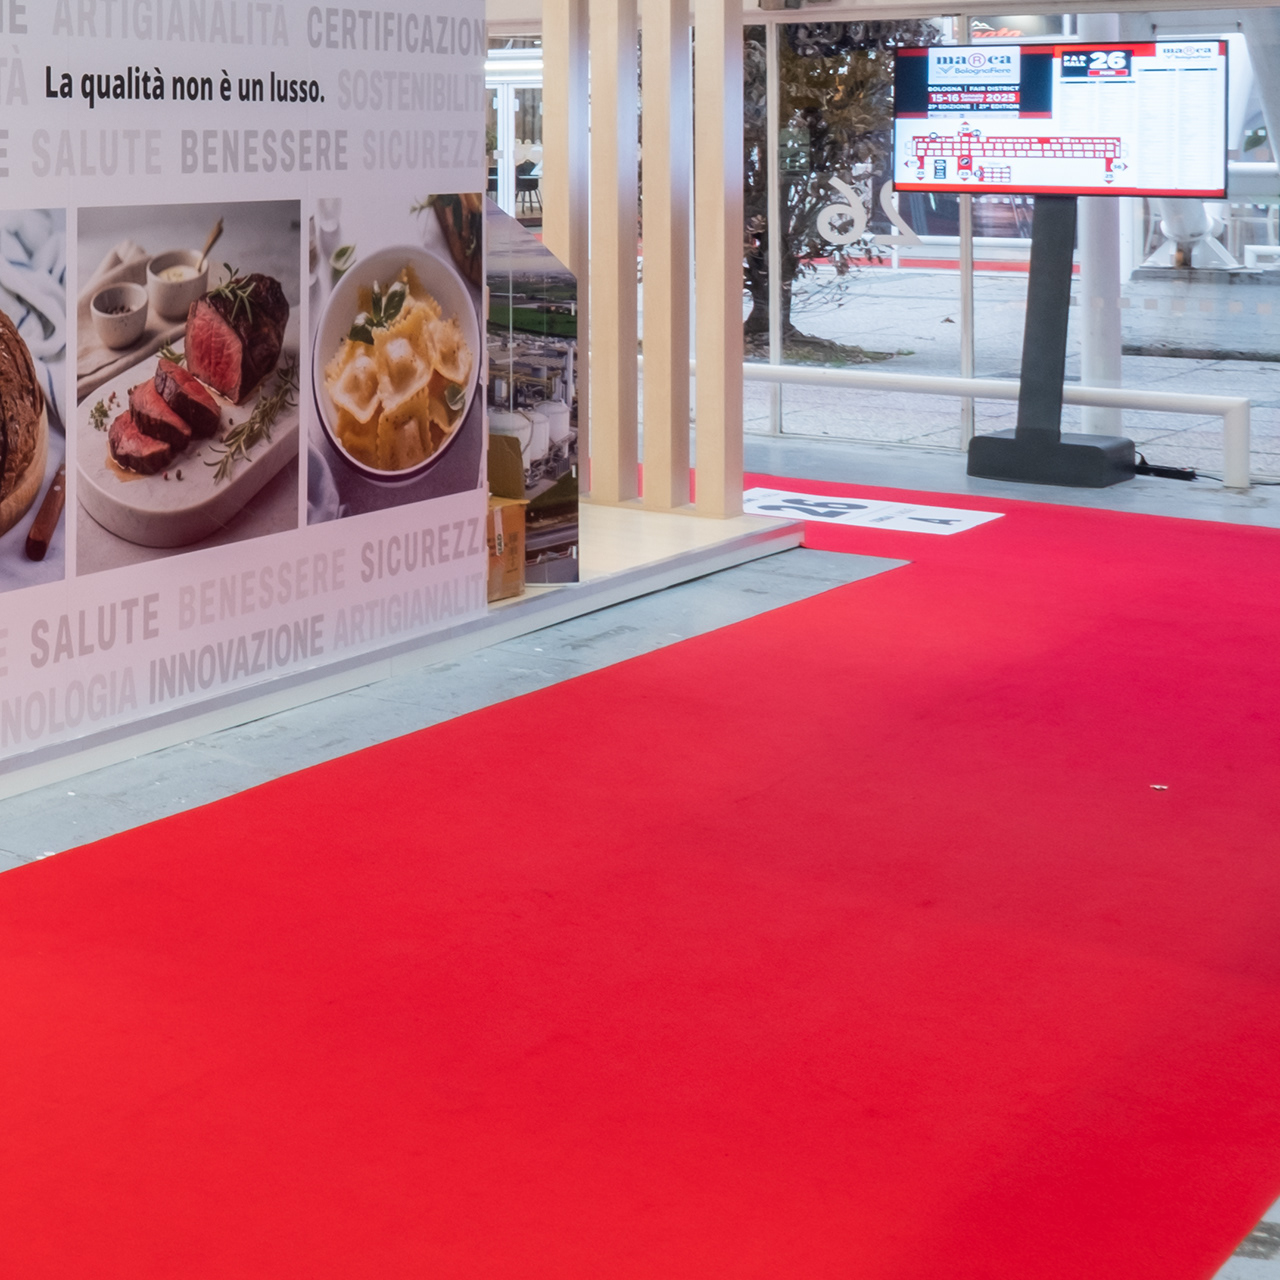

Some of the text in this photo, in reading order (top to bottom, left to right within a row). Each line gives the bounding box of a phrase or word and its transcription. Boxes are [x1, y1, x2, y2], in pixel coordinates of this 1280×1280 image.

[1090, 51, 1126, 69] 26
[46, 66, 325, 109] La qualità non è un lusso.
[931, 94, 959, 102] 15-16
[986, 94, 1016, 102] 2025
[30, 127, 163, 178] SALUTE
[179, 127, 348, 175] BENESSERE
[362, 128, 484, 172] SICUREZZ
[29, 590, 159, 671] SALUTE
[178, 546, 346, 632] BENESSERE
[360, 513, 487, 585] SICUREZZ
[148, 612, 324, 706] INNOVAZIONE
[332, 568, 486, 652] ARTIGIANALIT
